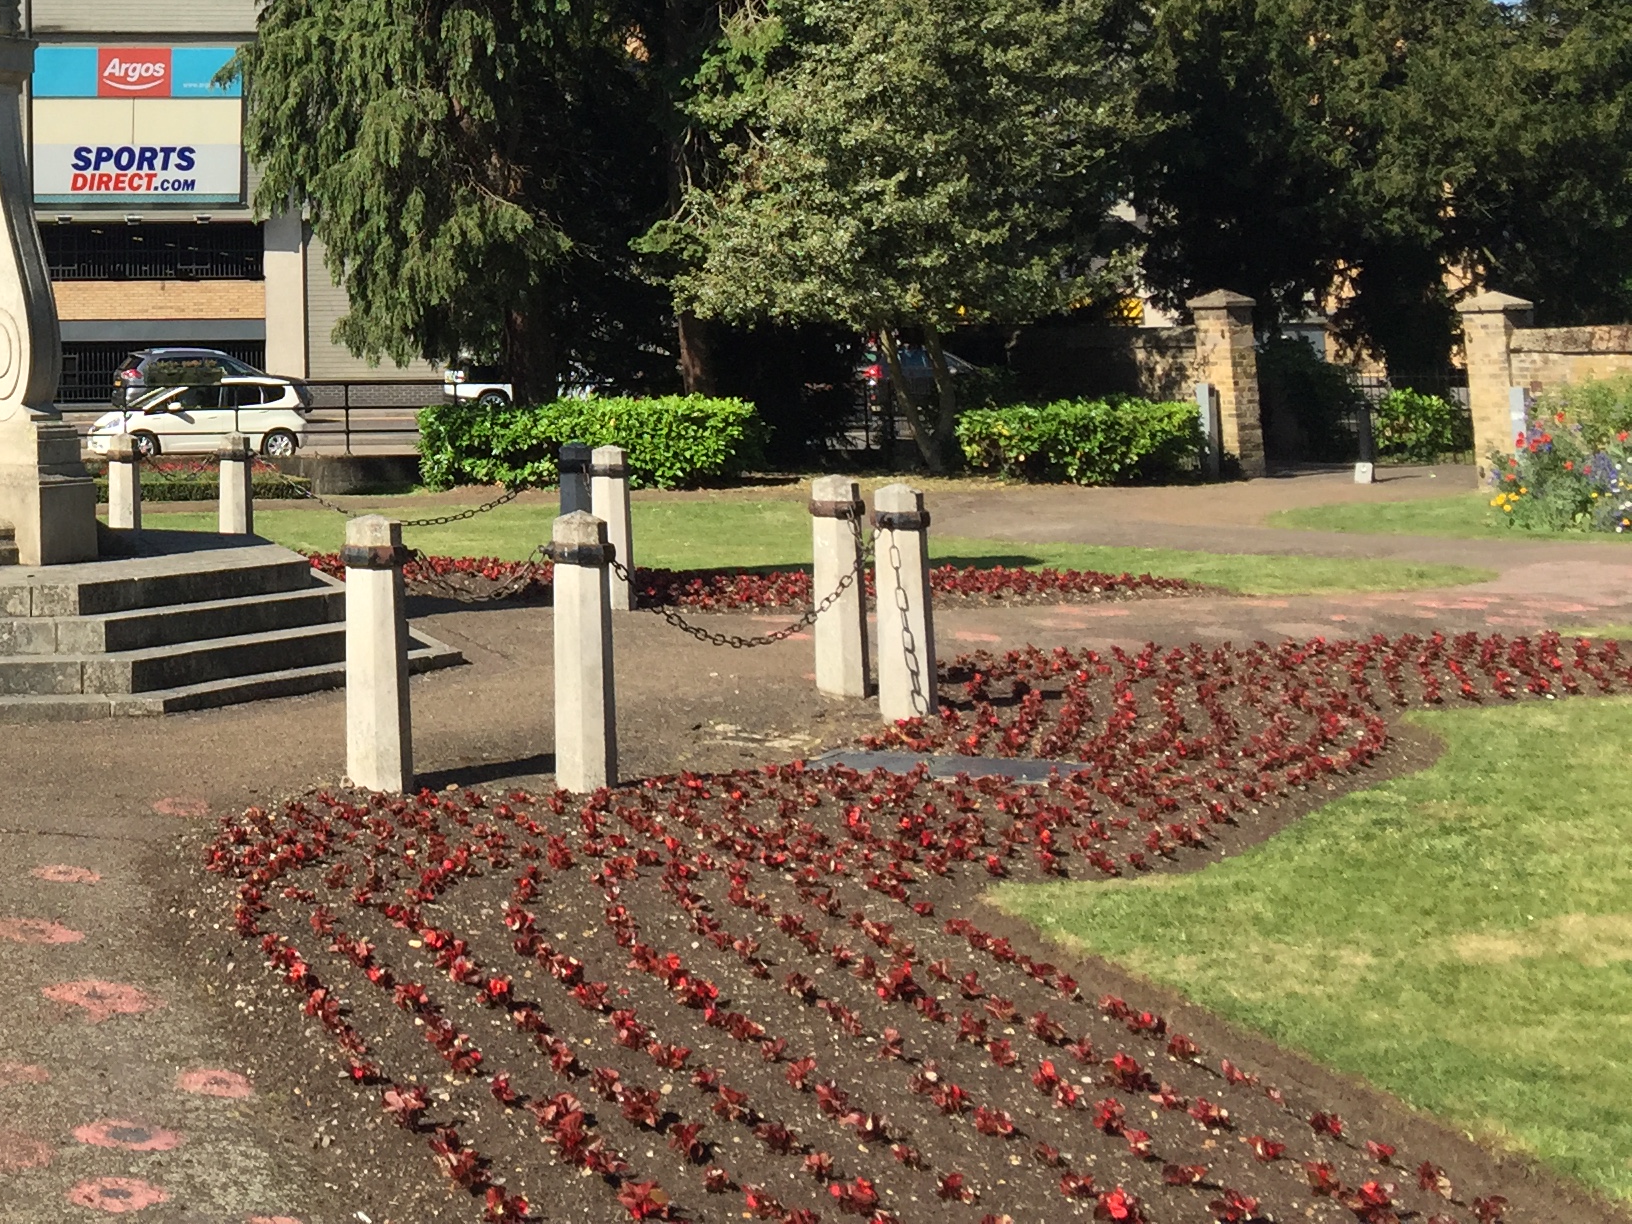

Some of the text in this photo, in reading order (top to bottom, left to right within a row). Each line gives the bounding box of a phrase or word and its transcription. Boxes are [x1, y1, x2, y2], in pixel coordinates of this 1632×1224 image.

[103, 58, 165, 82] Argos
[71, 146, 196, 171] SPORTS
[70, 173, 196, 191] DIRECT.COM
